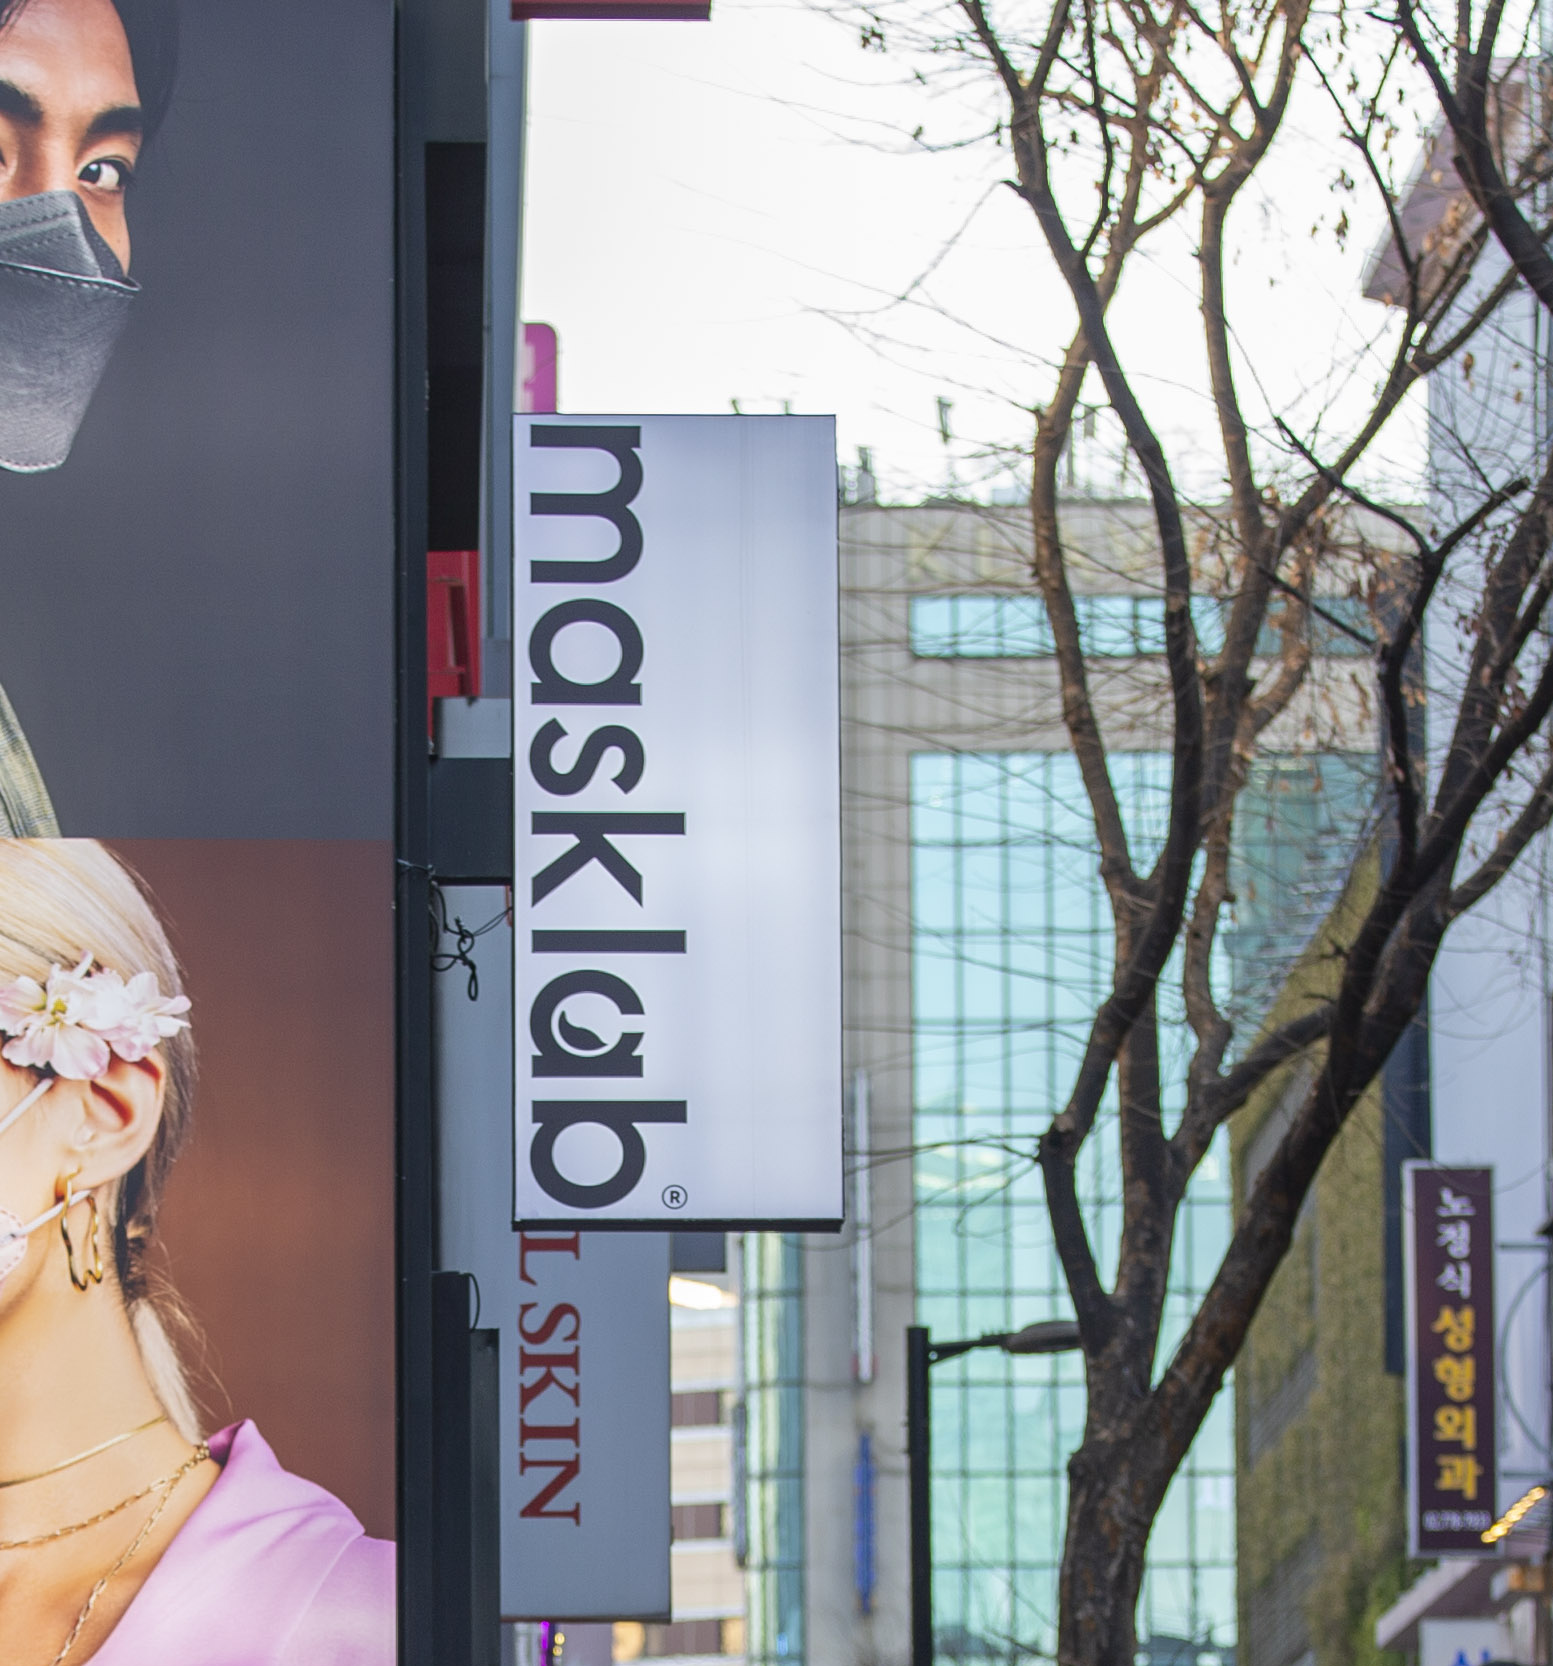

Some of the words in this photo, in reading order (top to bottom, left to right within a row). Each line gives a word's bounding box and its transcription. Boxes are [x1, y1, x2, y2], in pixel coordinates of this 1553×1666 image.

[529, 424, 689, 1209] masklab
[518, 1301, 581, 1527] SKIN
[1431, 1305, 1486, 1501] 성형외과
